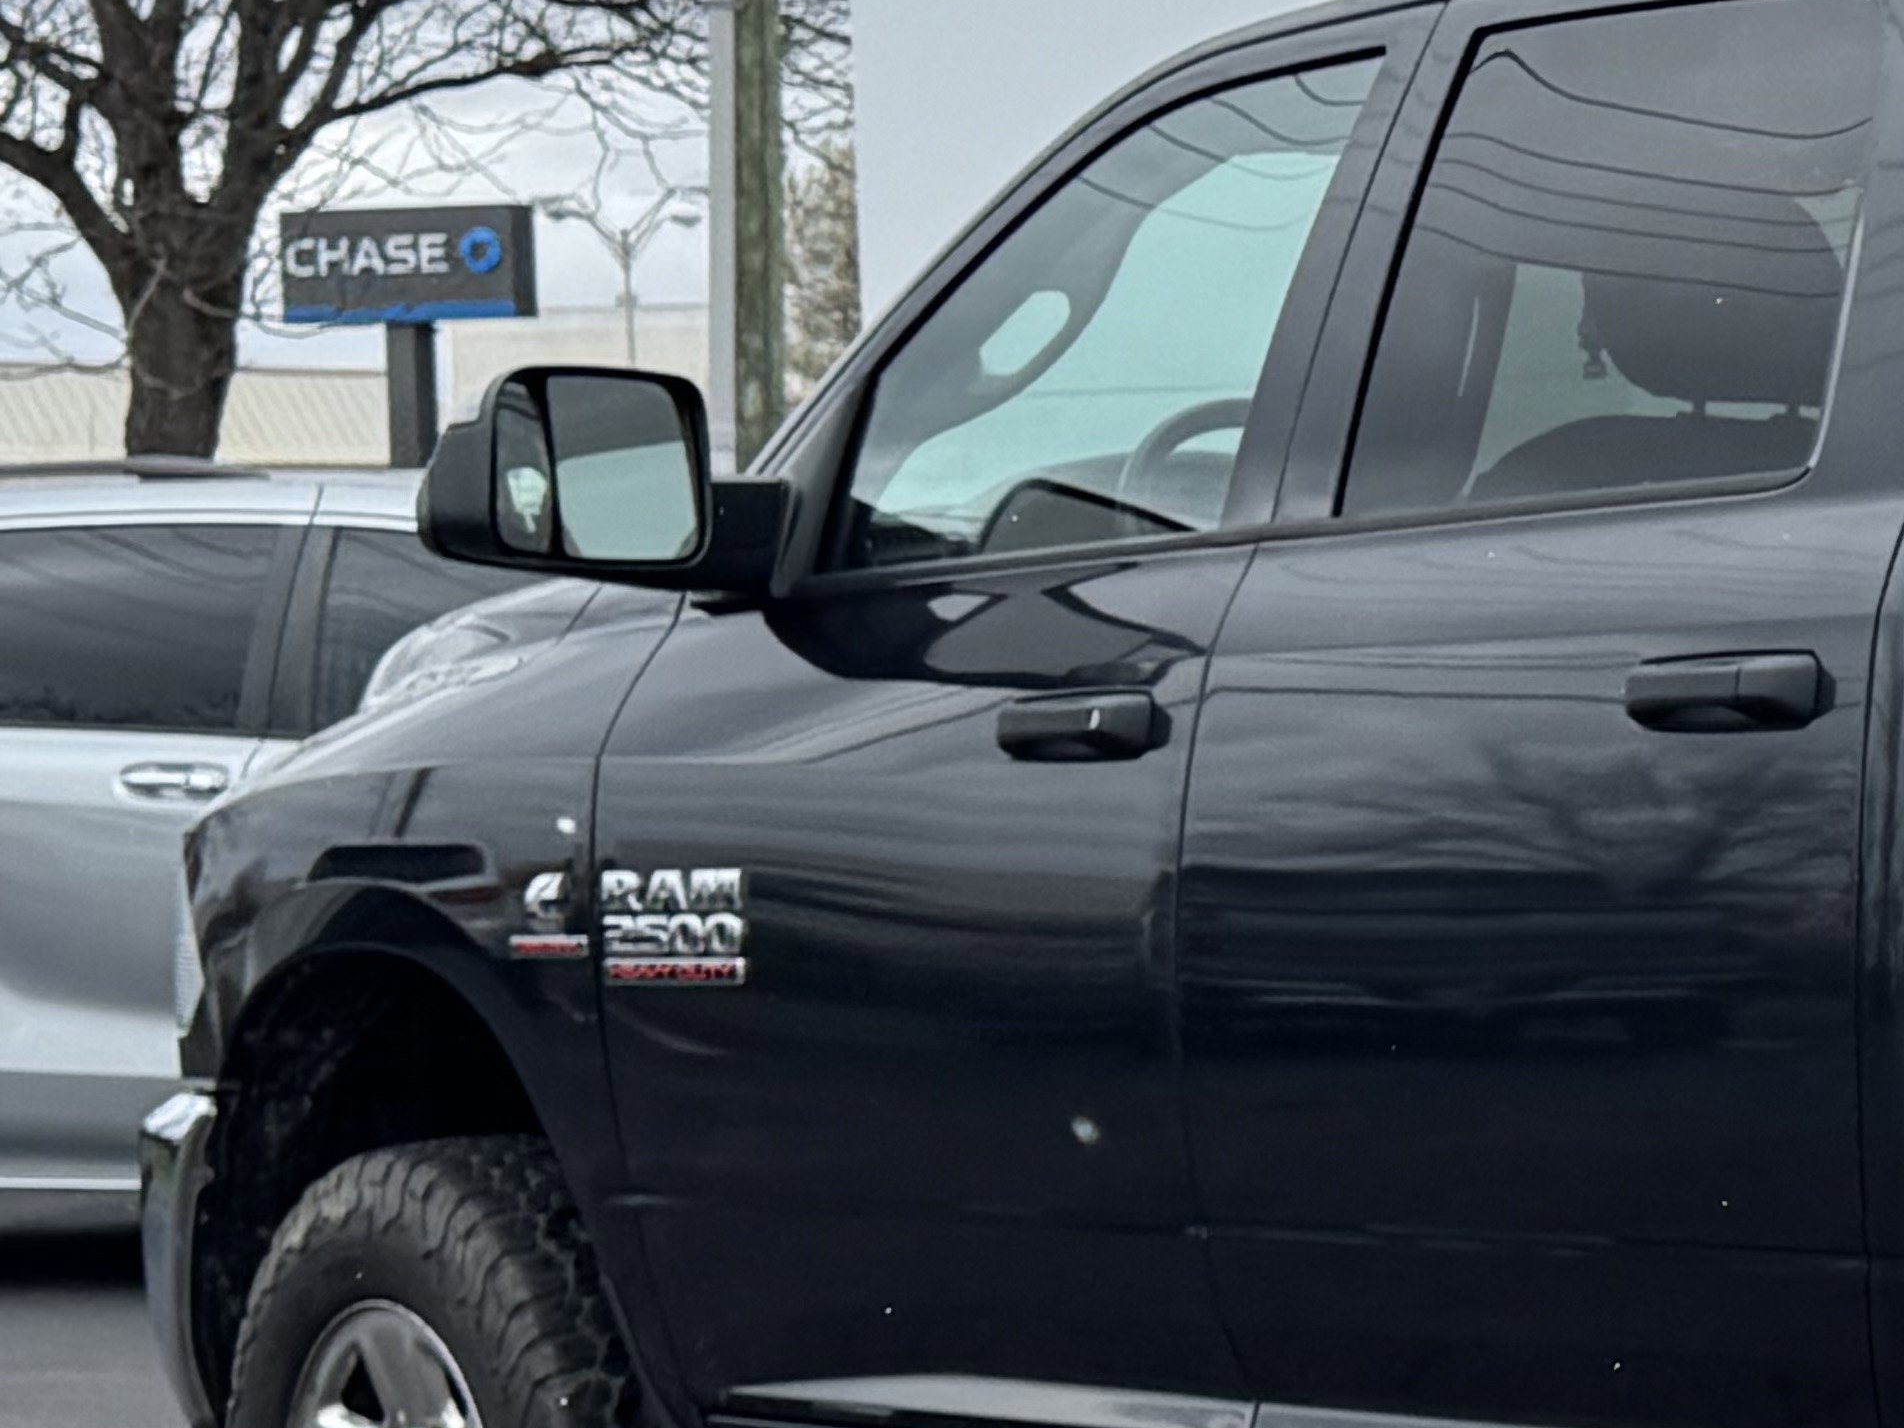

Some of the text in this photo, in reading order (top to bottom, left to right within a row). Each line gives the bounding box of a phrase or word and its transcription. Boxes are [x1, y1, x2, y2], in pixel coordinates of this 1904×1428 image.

[285, 231, 450, 278] CHASE
[601, 868, 743, 912] RAM
[602, 913, 743, 955] 2500
